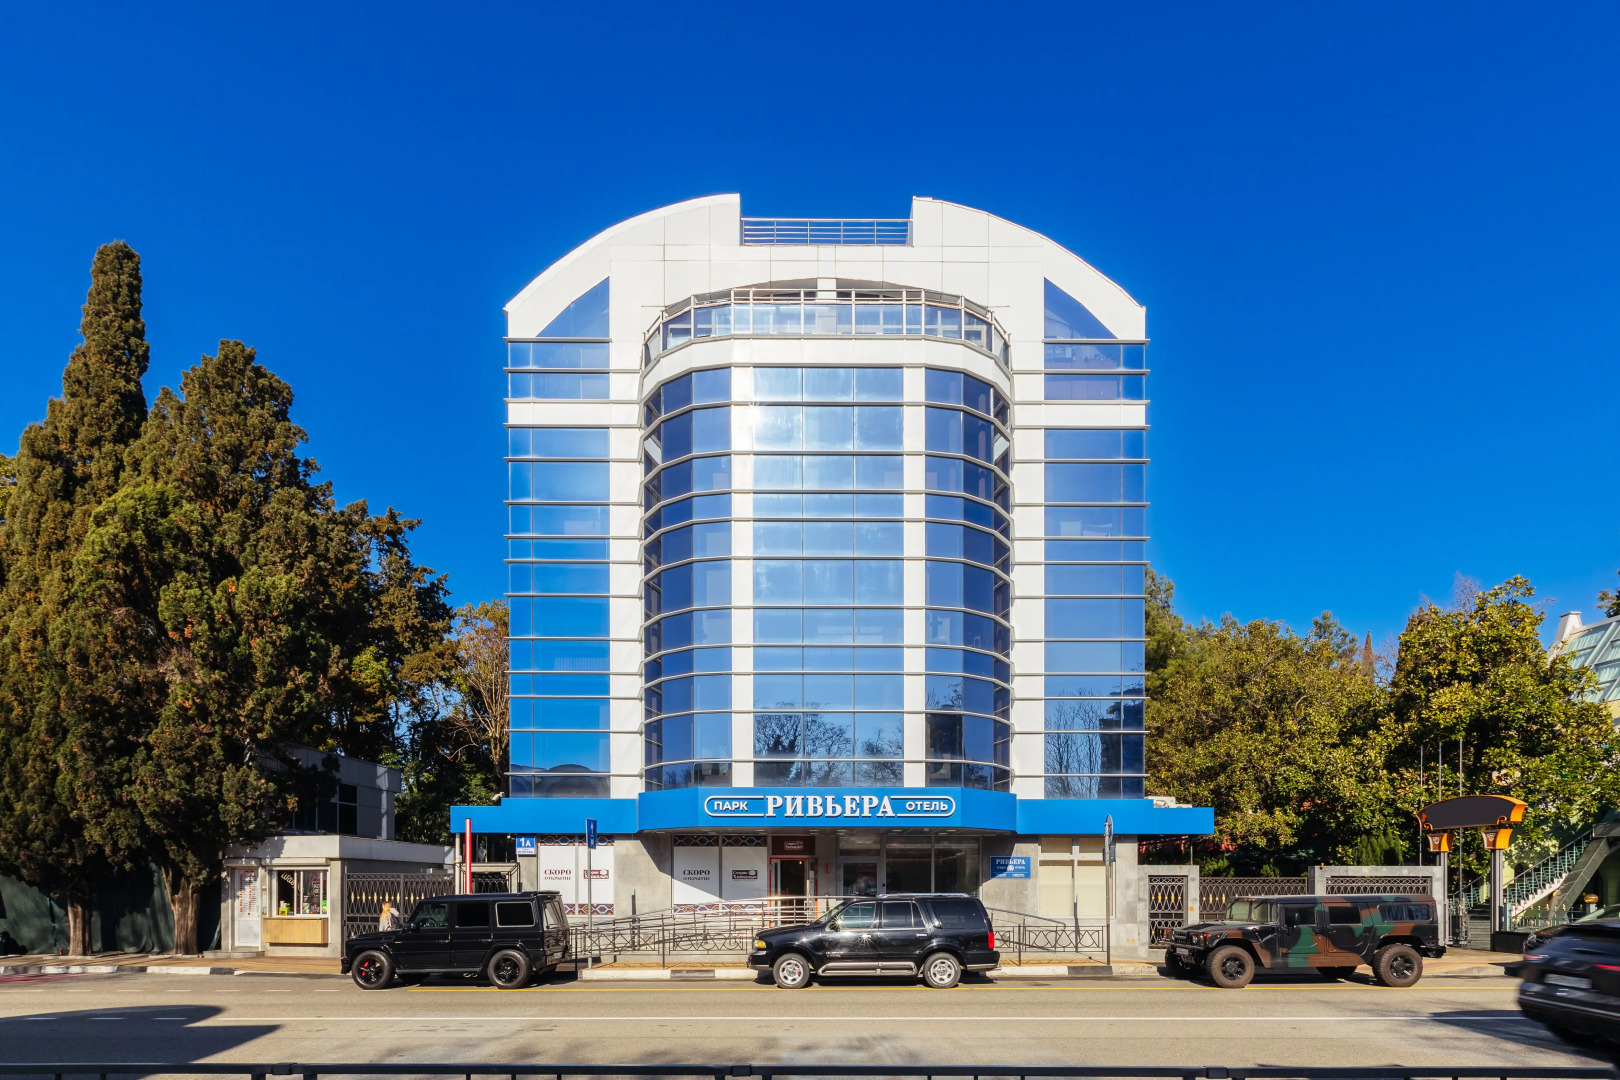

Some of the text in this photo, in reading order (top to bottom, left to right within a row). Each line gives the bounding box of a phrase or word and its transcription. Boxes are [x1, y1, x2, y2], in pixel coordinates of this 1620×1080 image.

[713, 795, 949, 818] ПАРК РИВЬЕРА ОТЕЛЬ
